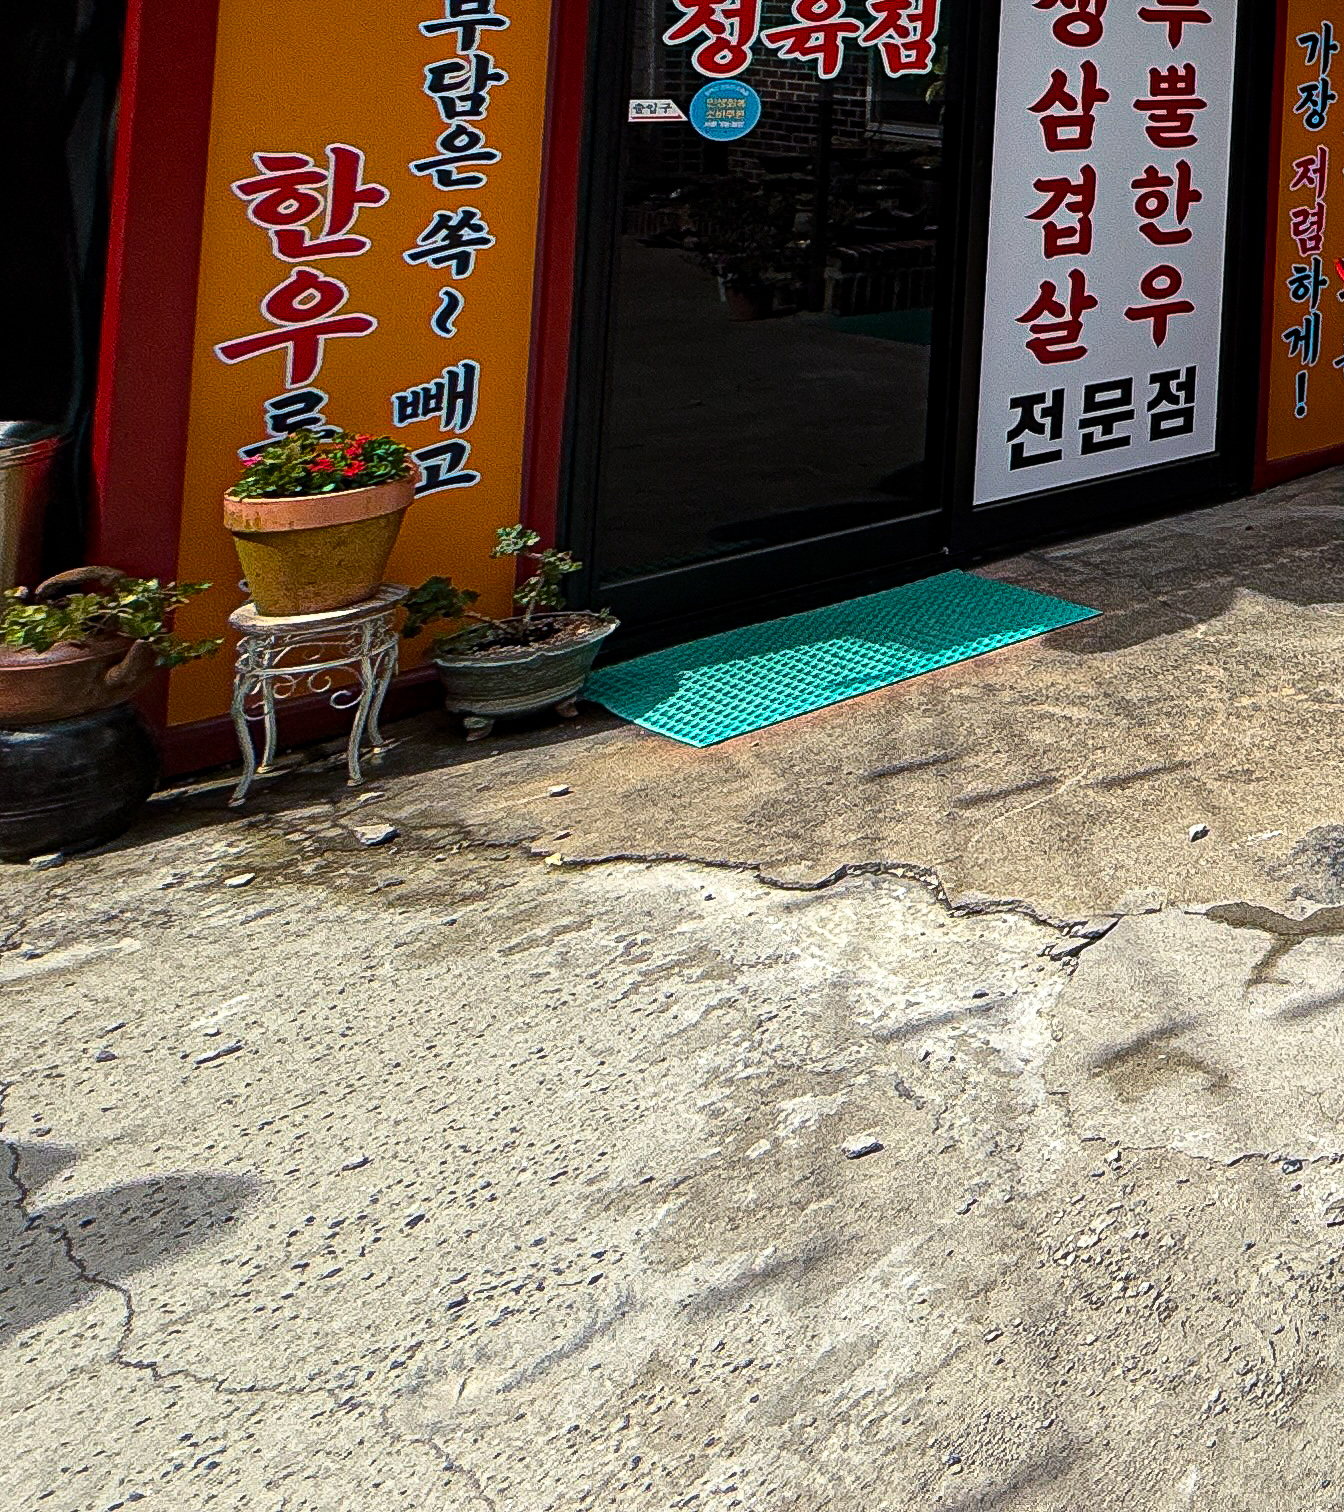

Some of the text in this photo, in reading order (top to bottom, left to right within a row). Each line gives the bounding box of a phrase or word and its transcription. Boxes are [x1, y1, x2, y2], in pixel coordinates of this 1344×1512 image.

[1294, 20, 1339, 132] 가장
[391, 359, 481, 499] 빼고
[1004, 364, 1199, 473] 전문점
